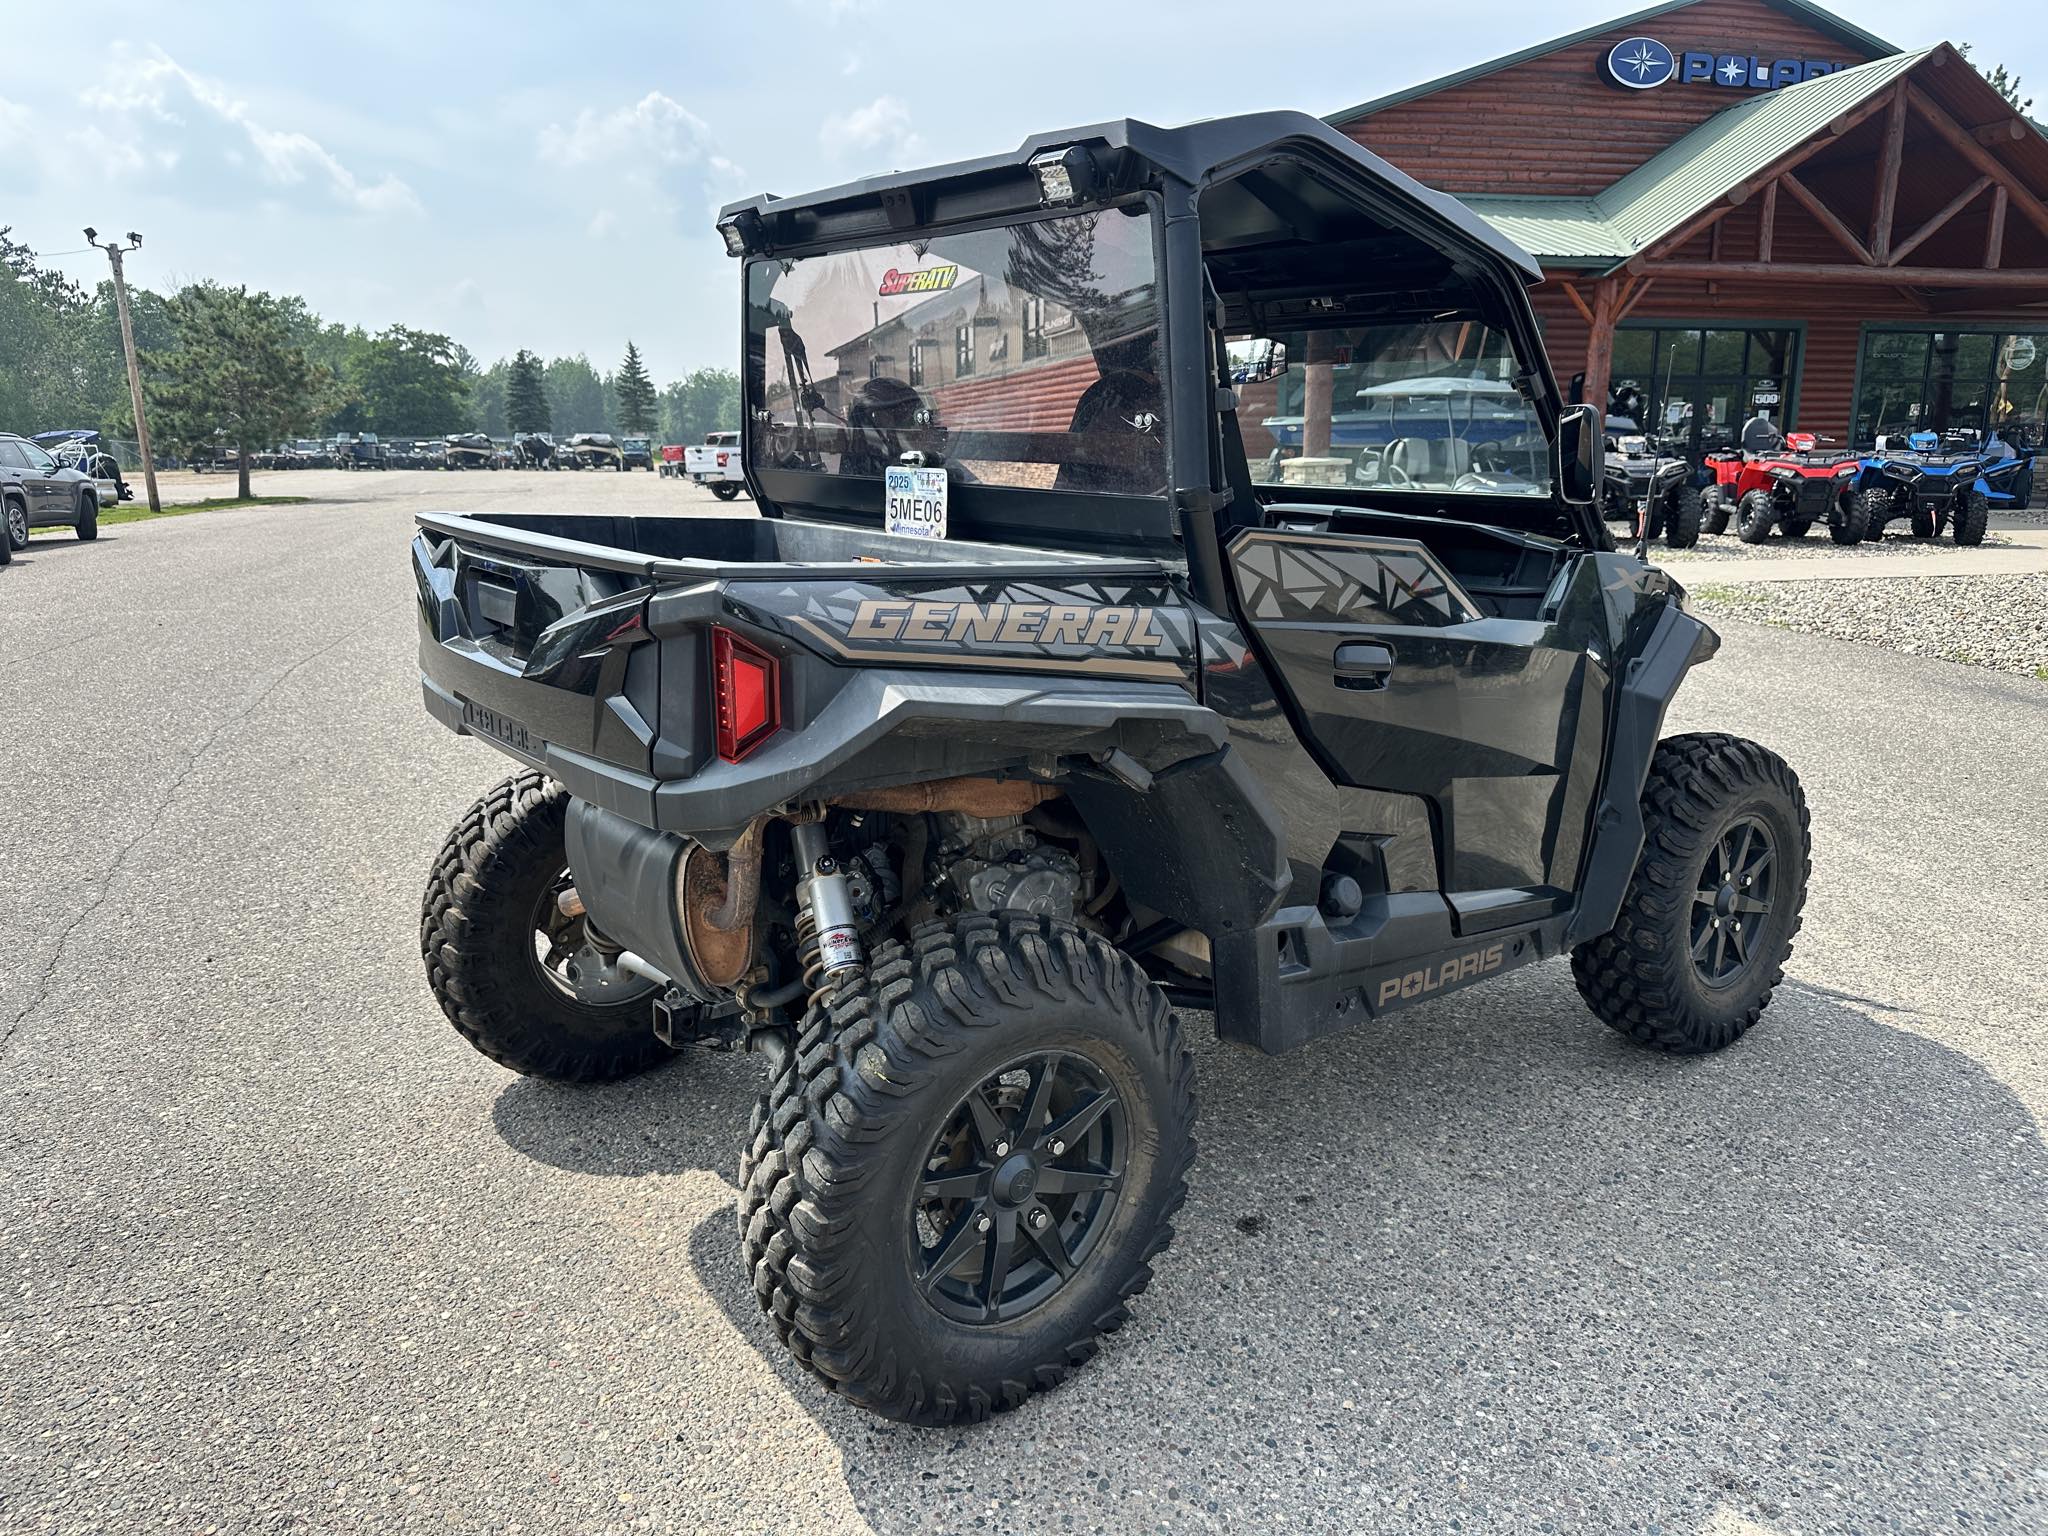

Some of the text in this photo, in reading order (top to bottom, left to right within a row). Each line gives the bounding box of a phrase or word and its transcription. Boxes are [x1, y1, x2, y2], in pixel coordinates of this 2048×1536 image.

[1680, 52, 1856, 89] POLAR
[879, 265, 957, 296] SUPERATV
[1754, 393, 1778, 404] 509
[888, 475, 910, 489] 2025
[890, 498, 942, 523] 5ME06
[893, 522, 930, 536] Minnesota
[846, 600, 1164, 647] GENERAL
[1378, 943, 1504, 1008] POLARIS
